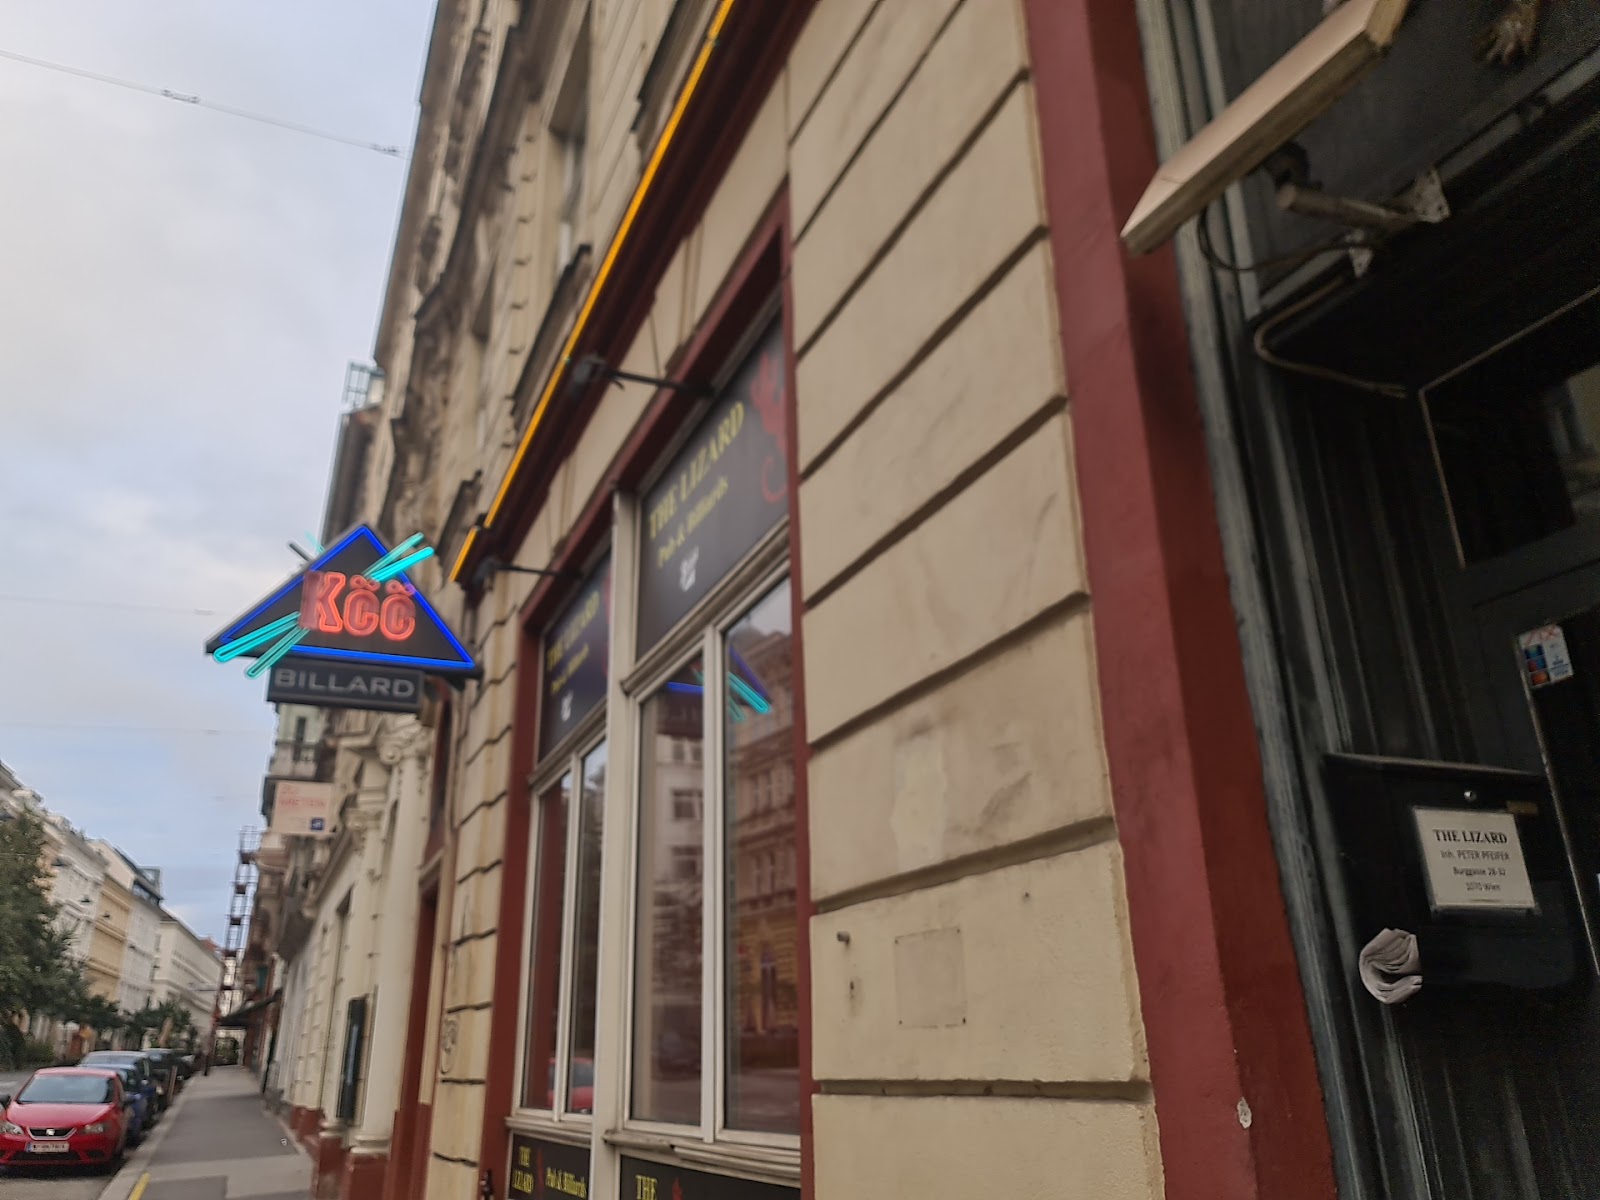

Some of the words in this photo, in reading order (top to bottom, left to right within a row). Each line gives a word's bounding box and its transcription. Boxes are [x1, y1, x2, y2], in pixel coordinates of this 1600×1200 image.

[649, 485, 677, 540] THE
[680, 401, 744, 502] LIZARD
[274, 668, 415, 698] BILLARD
[1432, 829, 1460, 842] THE
[1462, 830, 1508, 844] LIZARD
[1456, 850, 1480, 860] PETER
[635, 1174, 658, 1200] THE
